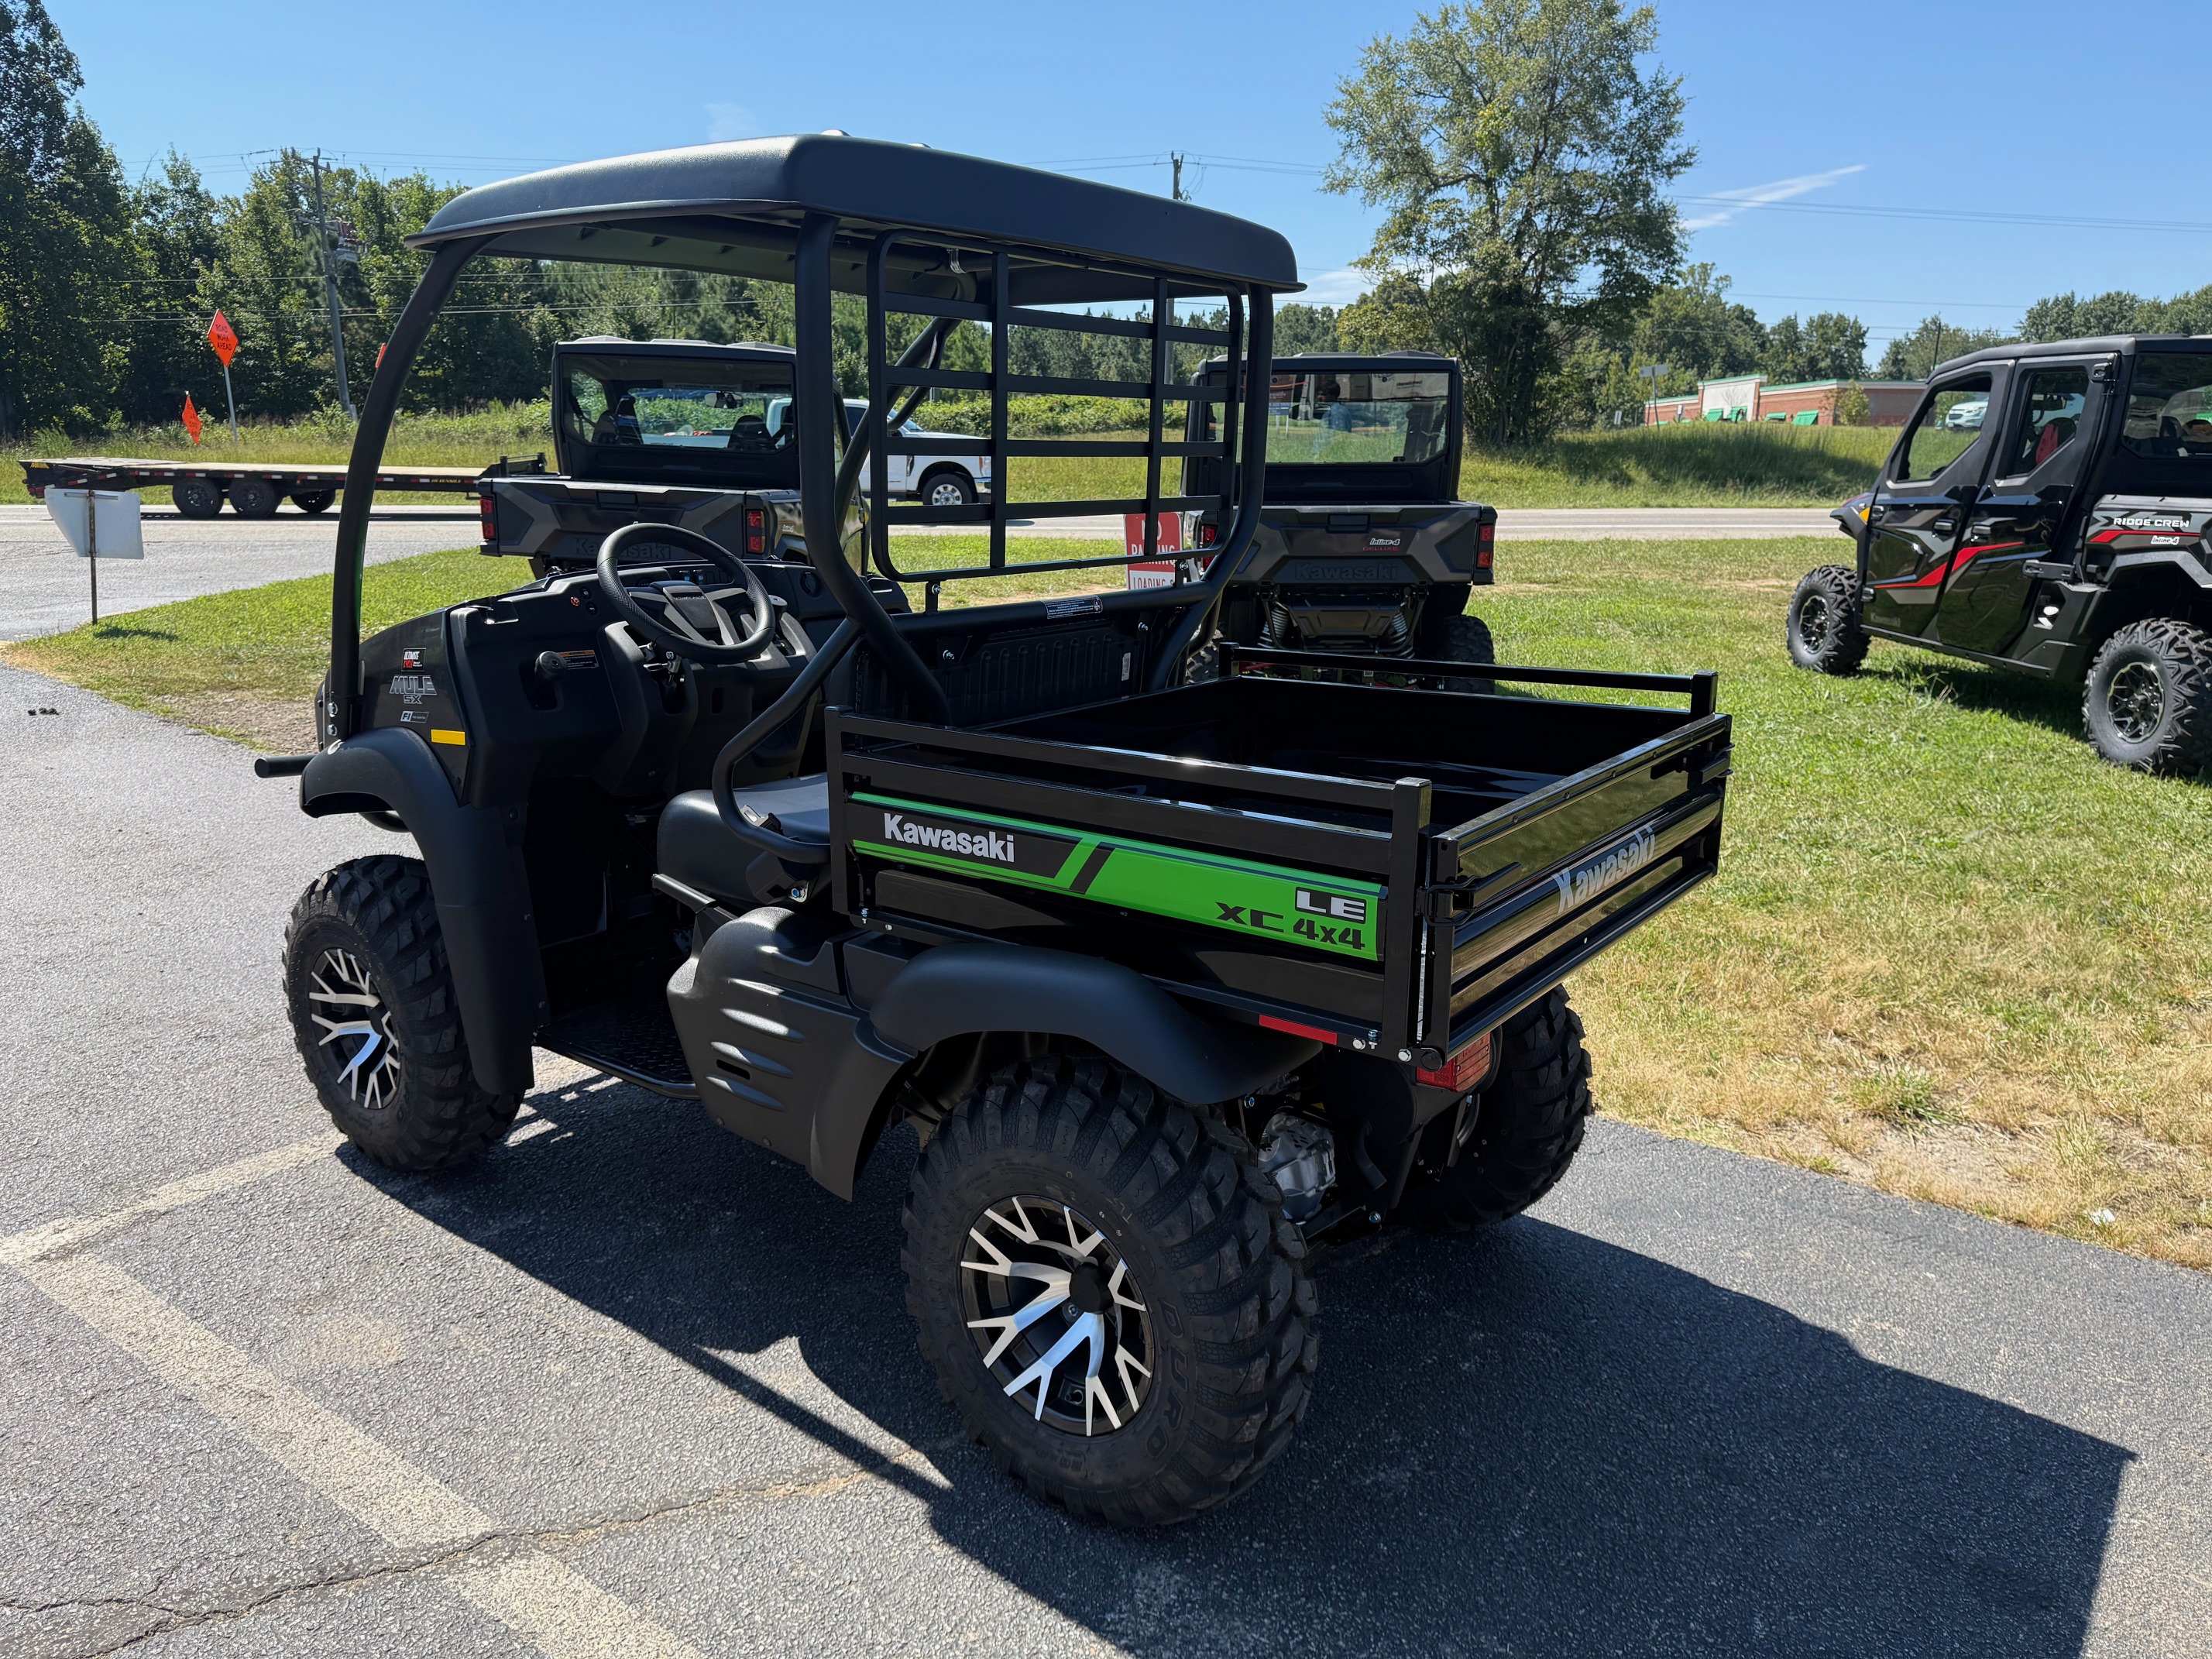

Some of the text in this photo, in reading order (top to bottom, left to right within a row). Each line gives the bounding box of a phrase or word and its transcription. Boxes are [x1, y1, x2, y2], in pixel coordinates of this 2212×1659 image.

[2114, 517, 2190, 527] RIDGE CREW
[572, 538, 672, 560] Kasaki
[1294, 562, 1396, 580] Kawasaki
[390, 675, 438, 696] MULE
[404, 695, 422, 704] SX
[884, 812, 1015, 863] Kawasaki
[1551, 823, 1656, 915] Kawasaki
[1214, 901, 1285, 933] XC
[1297, 890, 1365, 921] LE
[1293, 918, 1366, 950] 4x4
[1146, 1298, 1188, 1459] DURO
